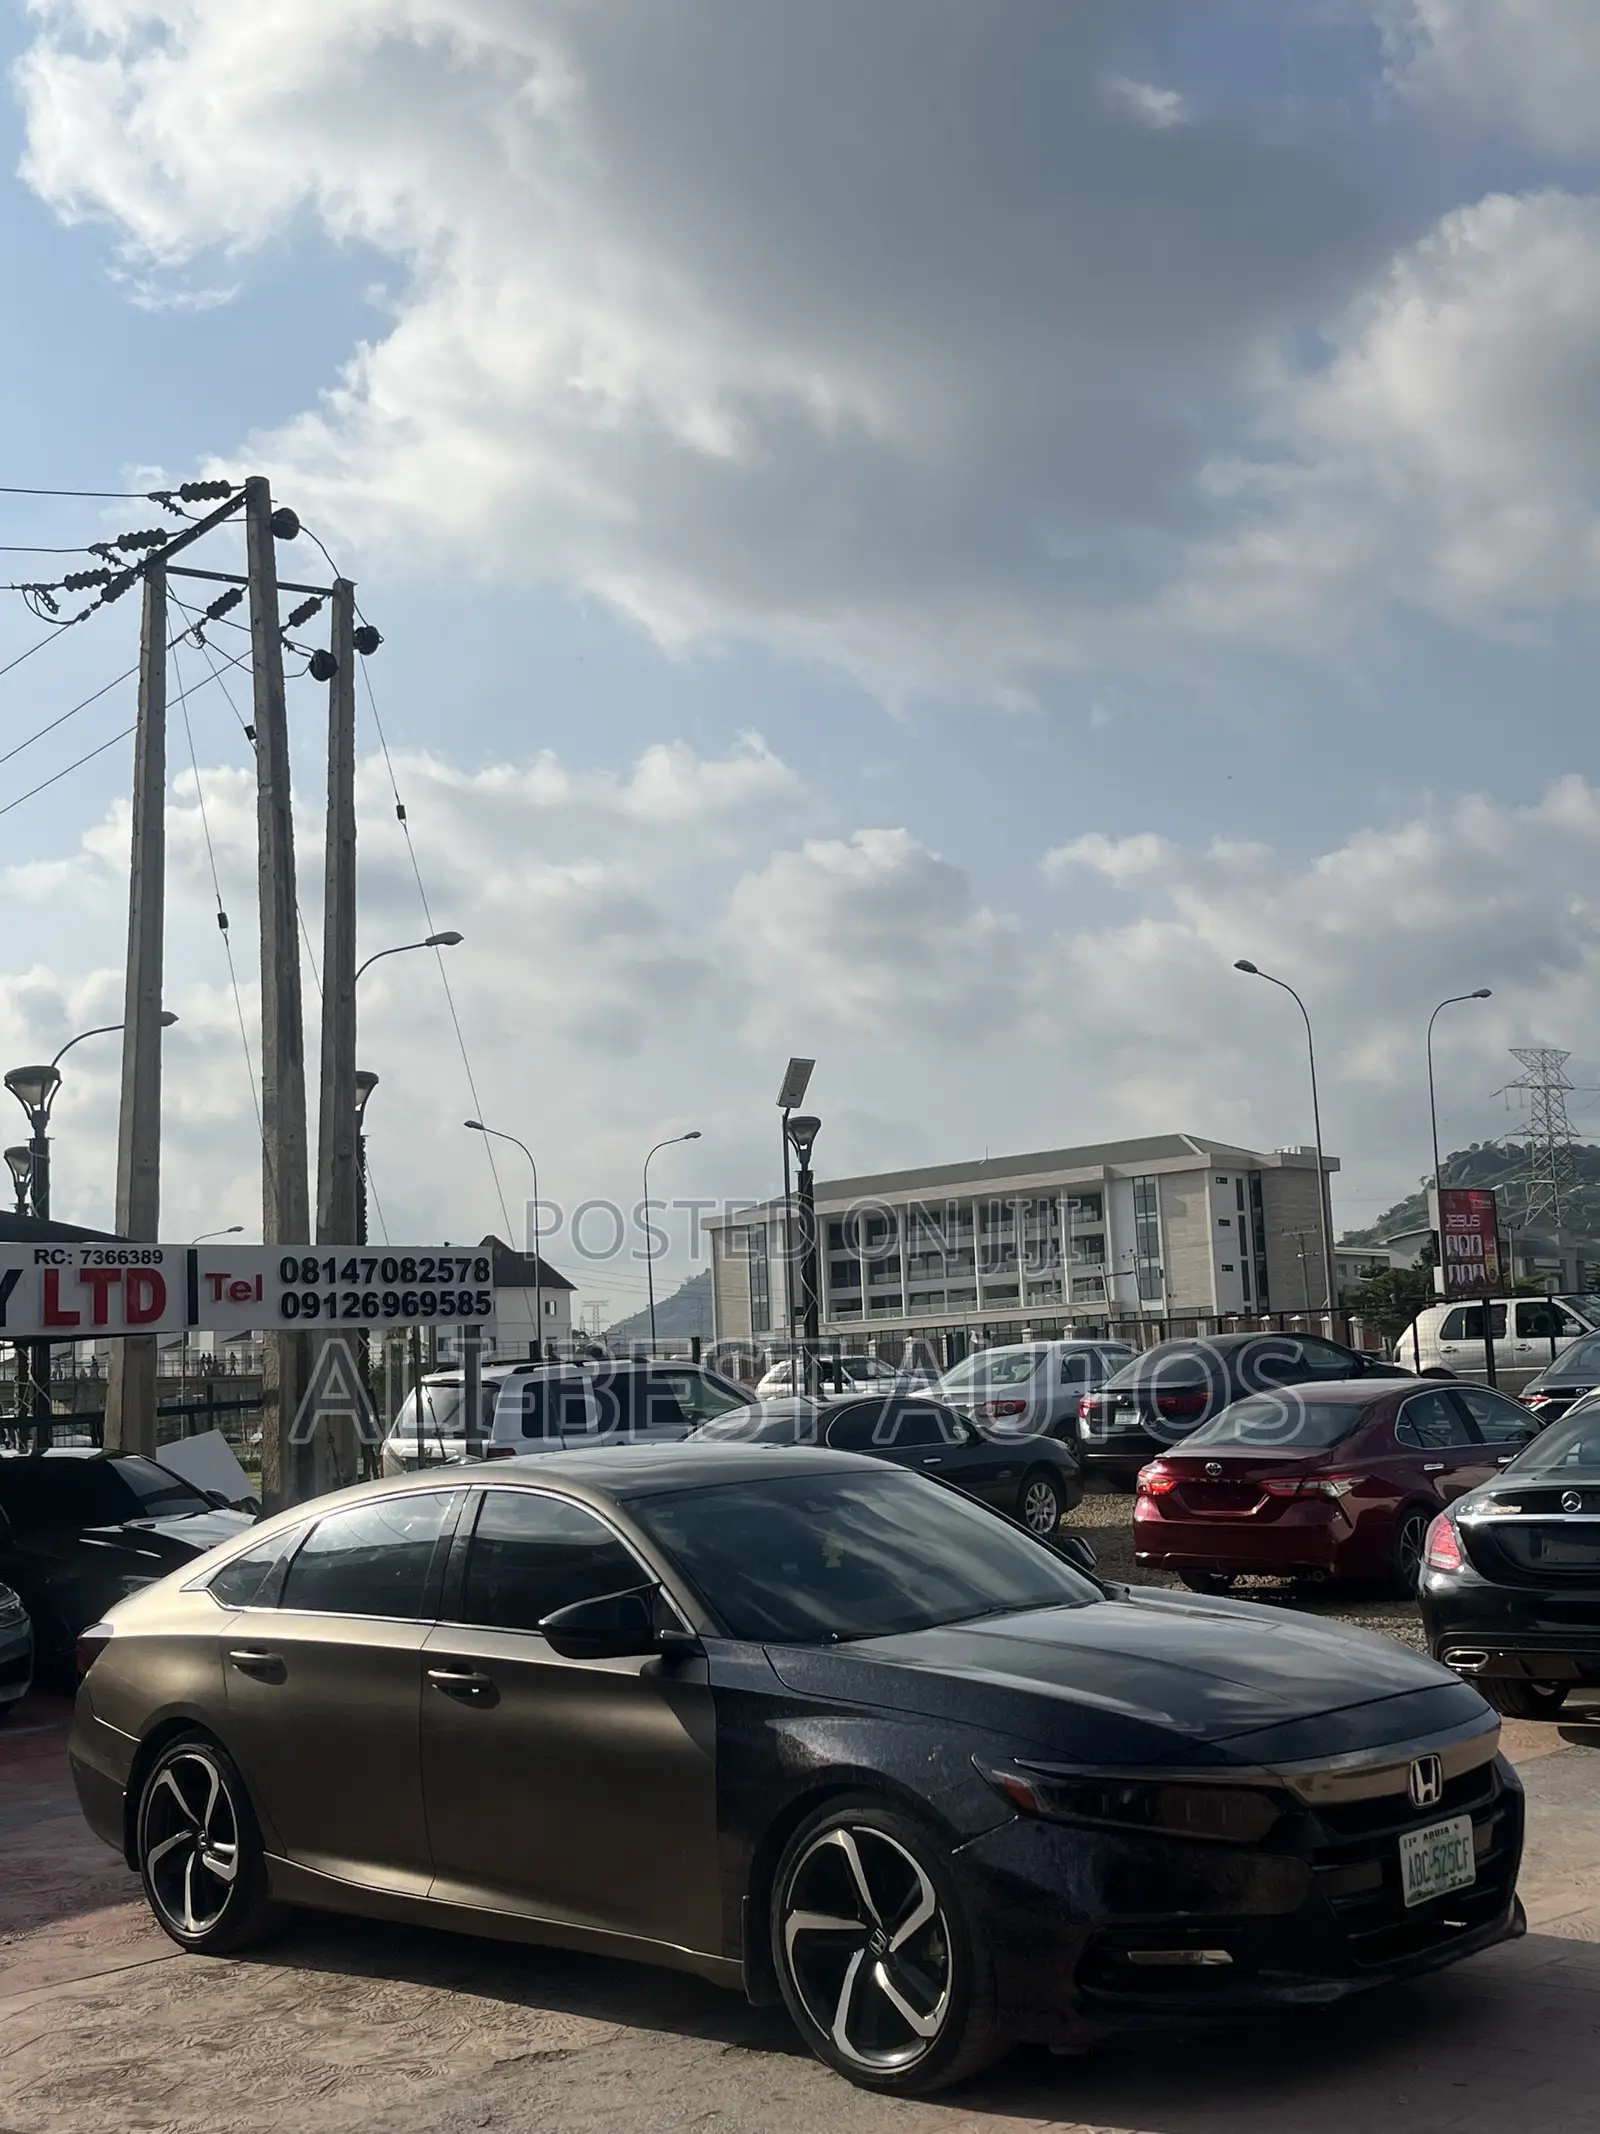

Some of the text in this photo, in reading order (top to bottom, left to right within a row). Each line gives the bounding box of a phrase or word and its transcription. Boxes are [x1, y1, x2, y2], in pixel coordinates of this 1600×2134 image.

[1445, 1214, 1481, 1228] JESUS
[34, 1249, 163, 1265] RC: 7366389
[280, 1256, 490, 1285] 08147082578
[43, 1268, 167, 1326] LTD
[205, 1273, 263, 1302] Tel
[281, 1290, 492, 1319] 09126969585
